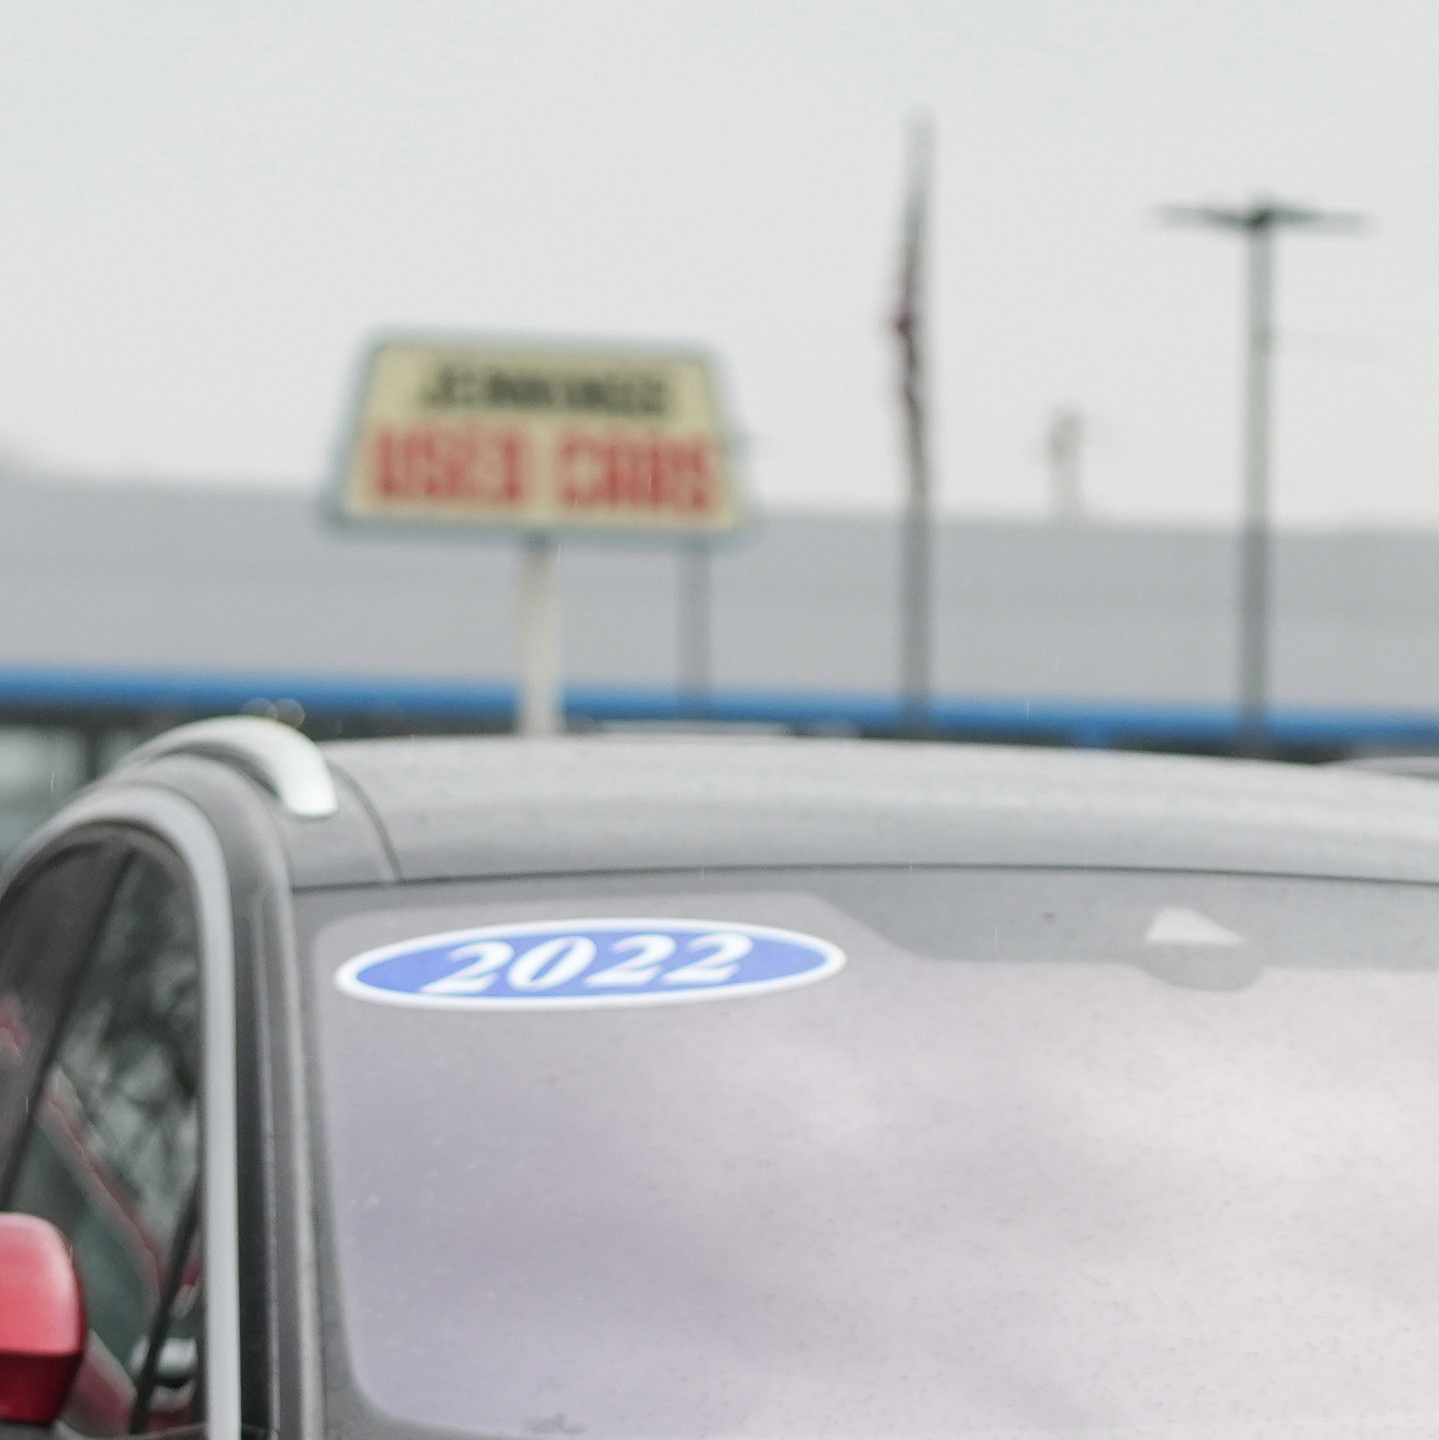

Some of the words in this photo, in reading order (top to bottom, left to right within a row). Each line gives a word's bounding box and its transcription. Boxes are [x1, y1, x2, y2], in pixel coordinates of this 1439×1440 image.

[371, 425, 525, 499] USED
[558, 431, 715, 508] CARS
[419, 933, 753, 996] 2022
